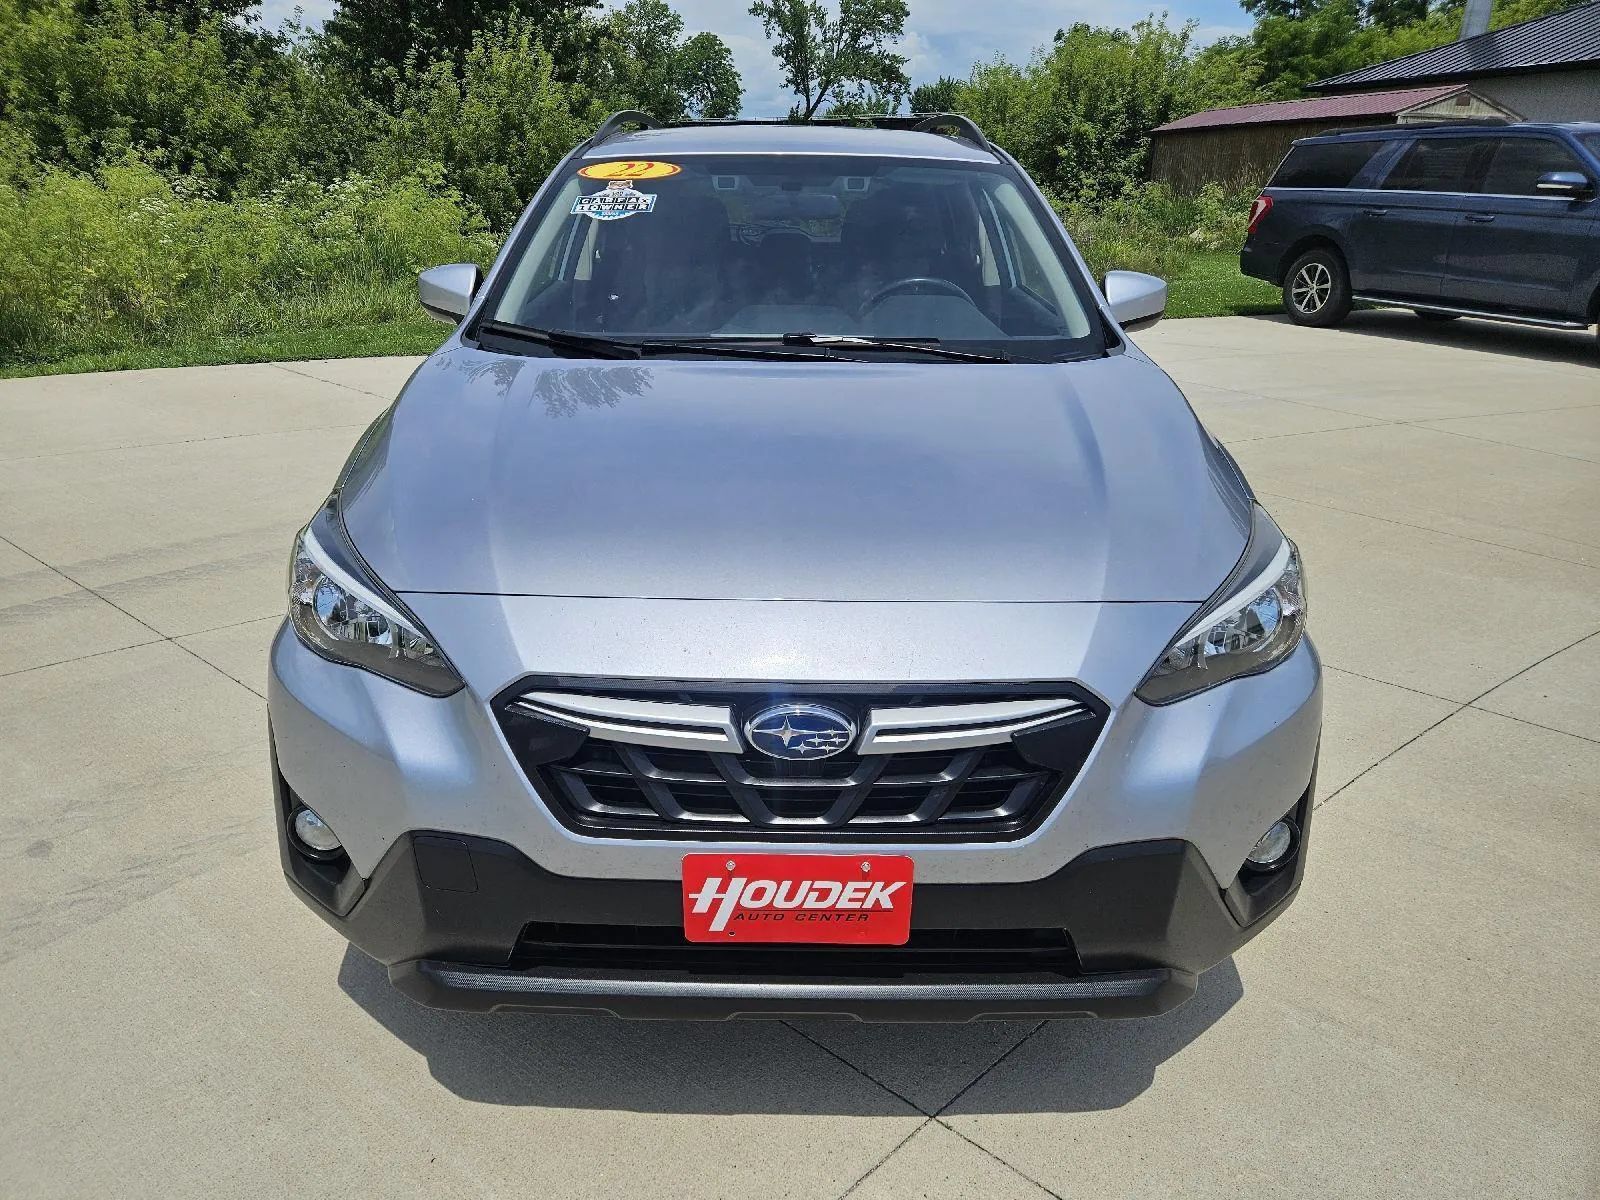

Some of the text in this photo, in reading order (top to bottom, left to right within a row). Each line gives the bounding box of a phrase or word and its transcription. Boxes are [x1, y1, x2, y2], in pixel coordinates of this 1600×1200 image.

[688, 877, 907, 932] HOUDEK
[733, 913, 869, 922] AUTO CENTER
